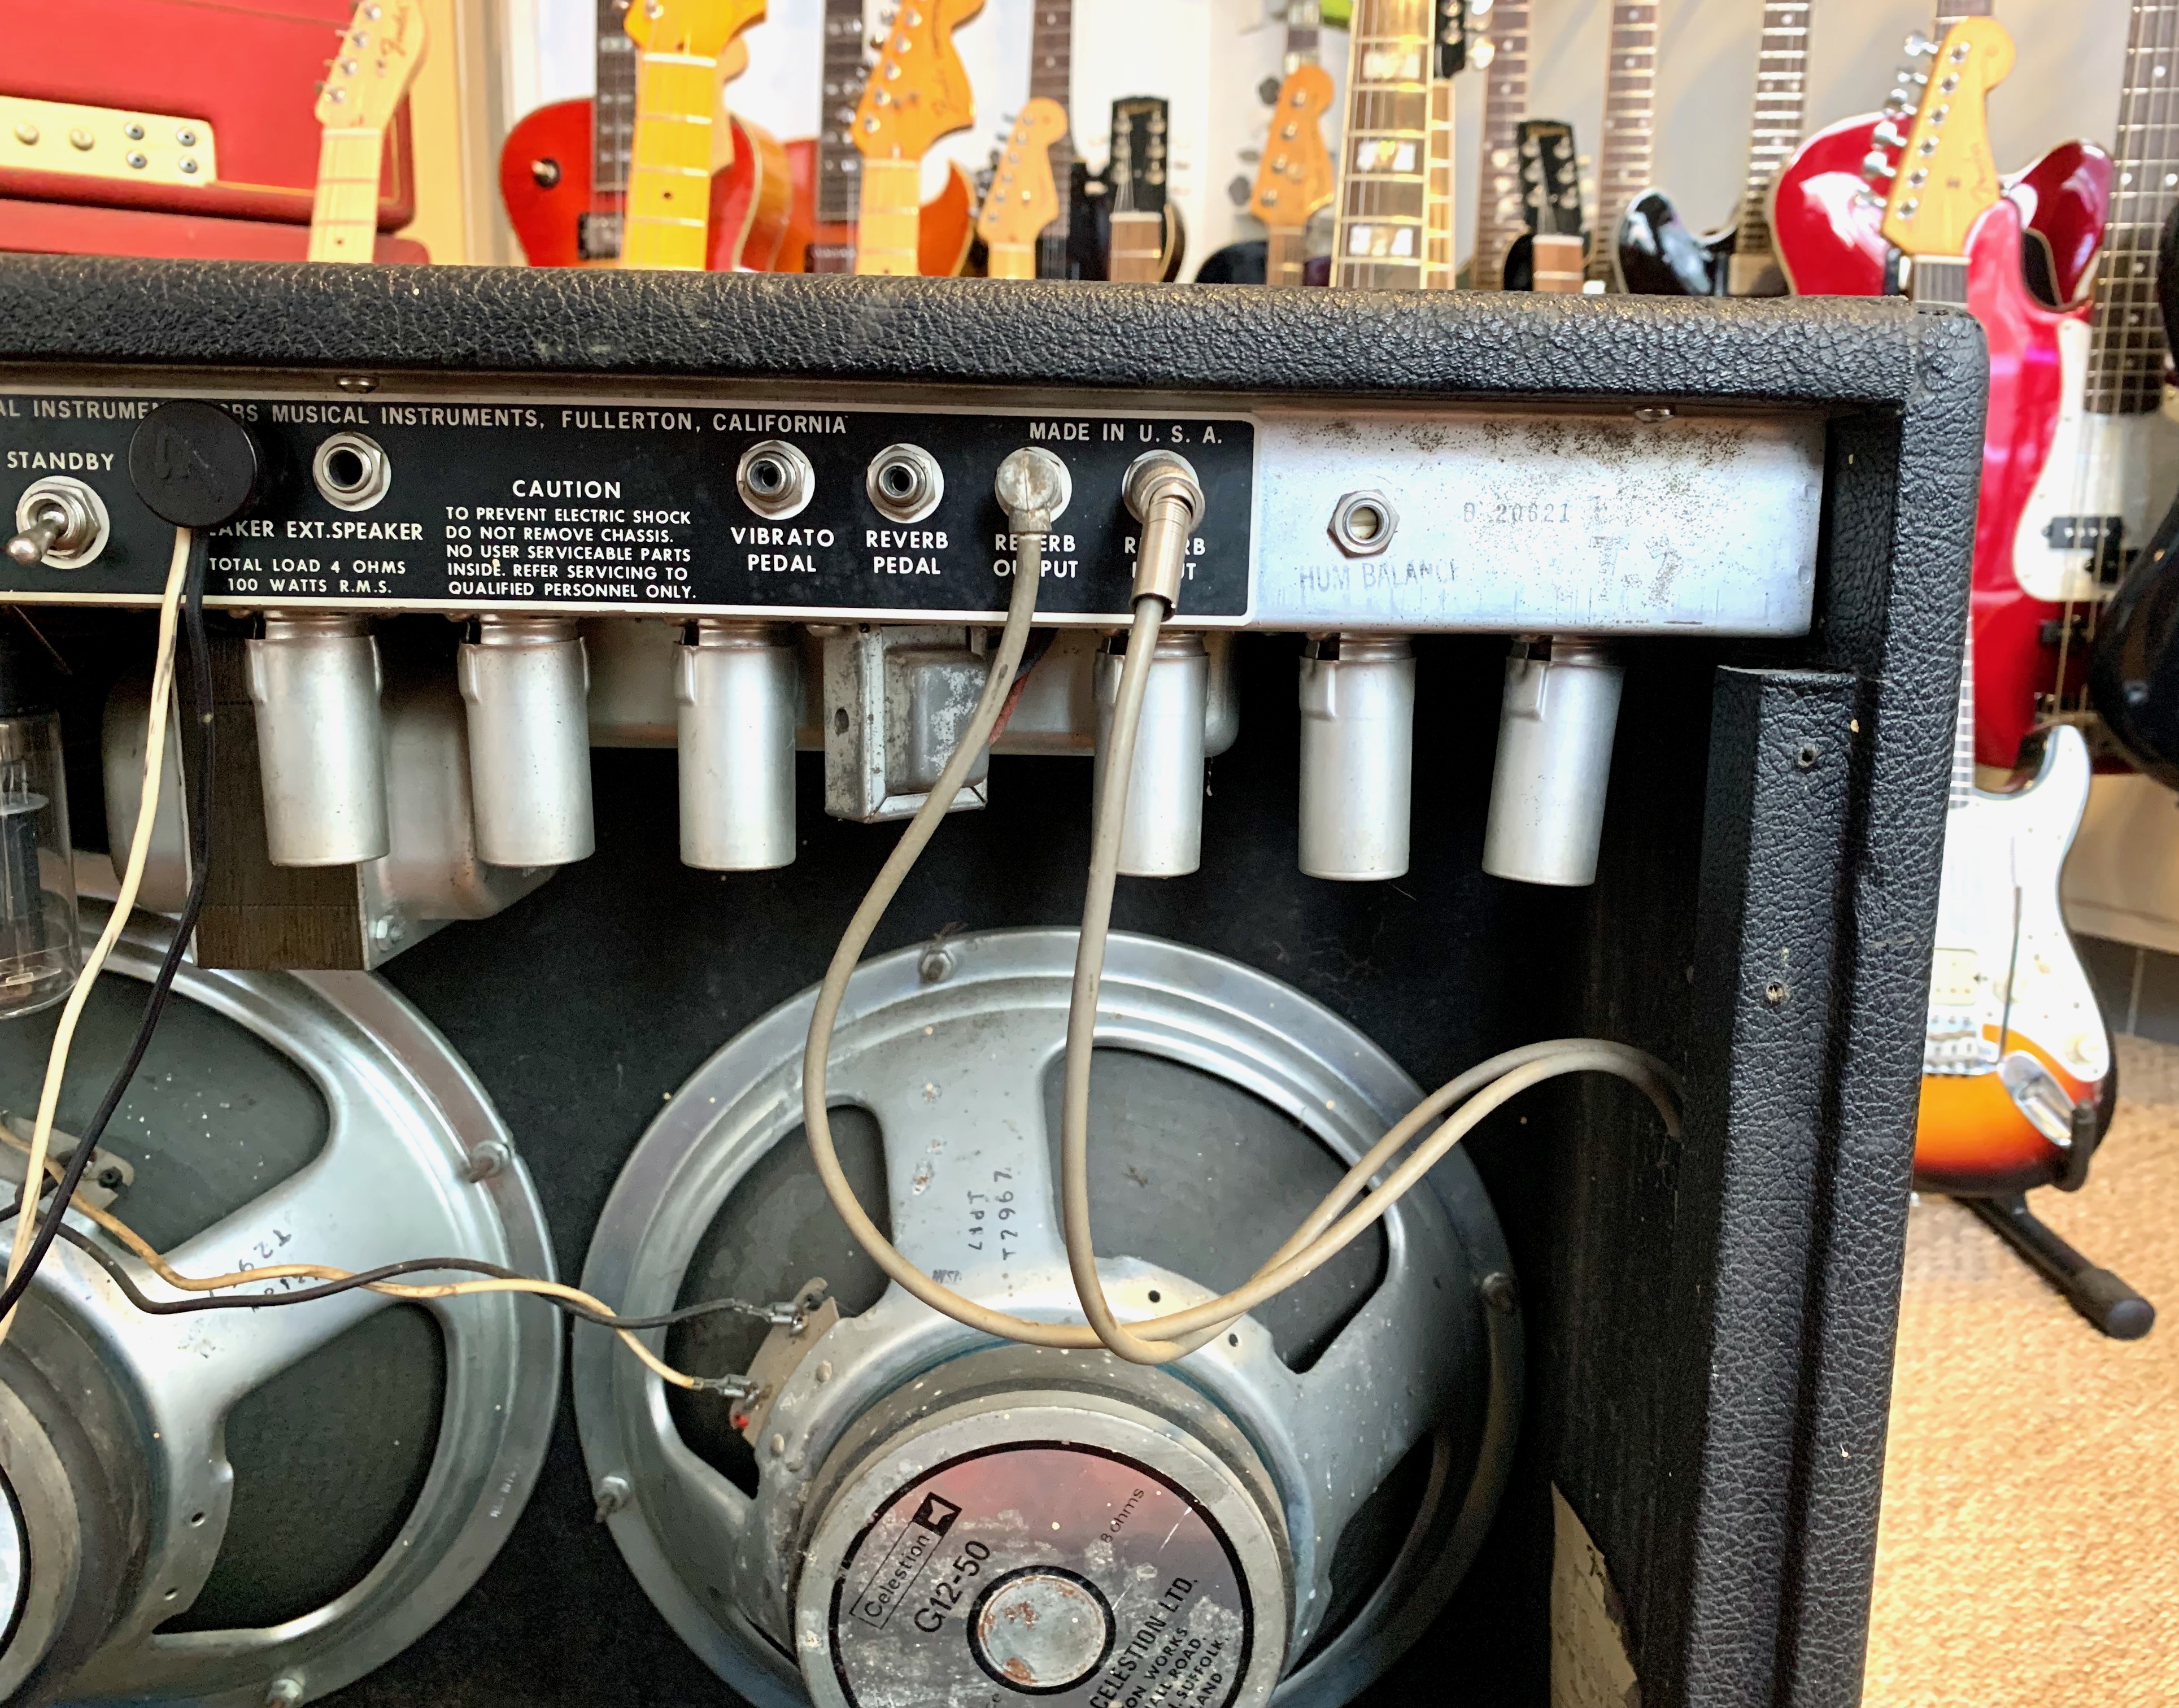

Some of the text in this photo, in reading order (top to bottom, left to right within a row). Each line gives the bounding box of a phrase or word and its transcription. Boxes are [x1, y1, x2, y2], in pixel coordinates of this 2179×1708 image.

[34, 400, 165, 419] INSTRUME
[220, 403, 259, 422] BS
[273, 404, 369, 425] MUSICAL
[381, 407, 544, 429] INSTRUMENTS,
[562, 411, 700, 433] FULLERTON,
[713, 413, 847, 434] CALIFORNIA
[1030, 422, 1222, 444] MADE IN U. S. A.
[7, 451, 114, 471] STANDBY
[512, 480, 621, 499] CAUTION
[446, 507, 691, 525] TO PREVENT ELECTRIC SHOCK
[210, 520, 274, 538] AKER
[287, 521, 424, 541] EXT.SPEAKER
[446, 526, 673, 543] DO NOT REMOVE CHASSIS.
[730, 527, 834, 547] VIBRATO
[866, 530, 948, 549] REVERB
[995, 534, 1076, 552] REERB
[447, 544, 691, 562] NO USER SERVICEABLE PARTS
[210, 557, 406, 574] TOTAL LOAD 4 OHMS
[448, 563, 687, 581] INSIDE. REFER SERVICING TO
[748, 554, 816, 572] PEDAL
[874, 556, 940, 574] PEDAL
[993, 559, 1078, 578] OPUT
[228, 578, 391, 594] 100 WATTS R.M.S.
[448, 582, 696, 599] QUALIFIED PERSONNEL ONLY.
[1100, 1488, 1145, 1544] 8 ohms
[864, 1533, 931, 1618] Celestion
[914, 1540, 991, 1633] G12-50
[1090, 1615, 1166, 1708] CELESTION
[1118, 1685, 1147, 1708] ON
[1144, 1627, 1188, 1680] WORKS
[1186, 1672, 1223, 1708] AND
